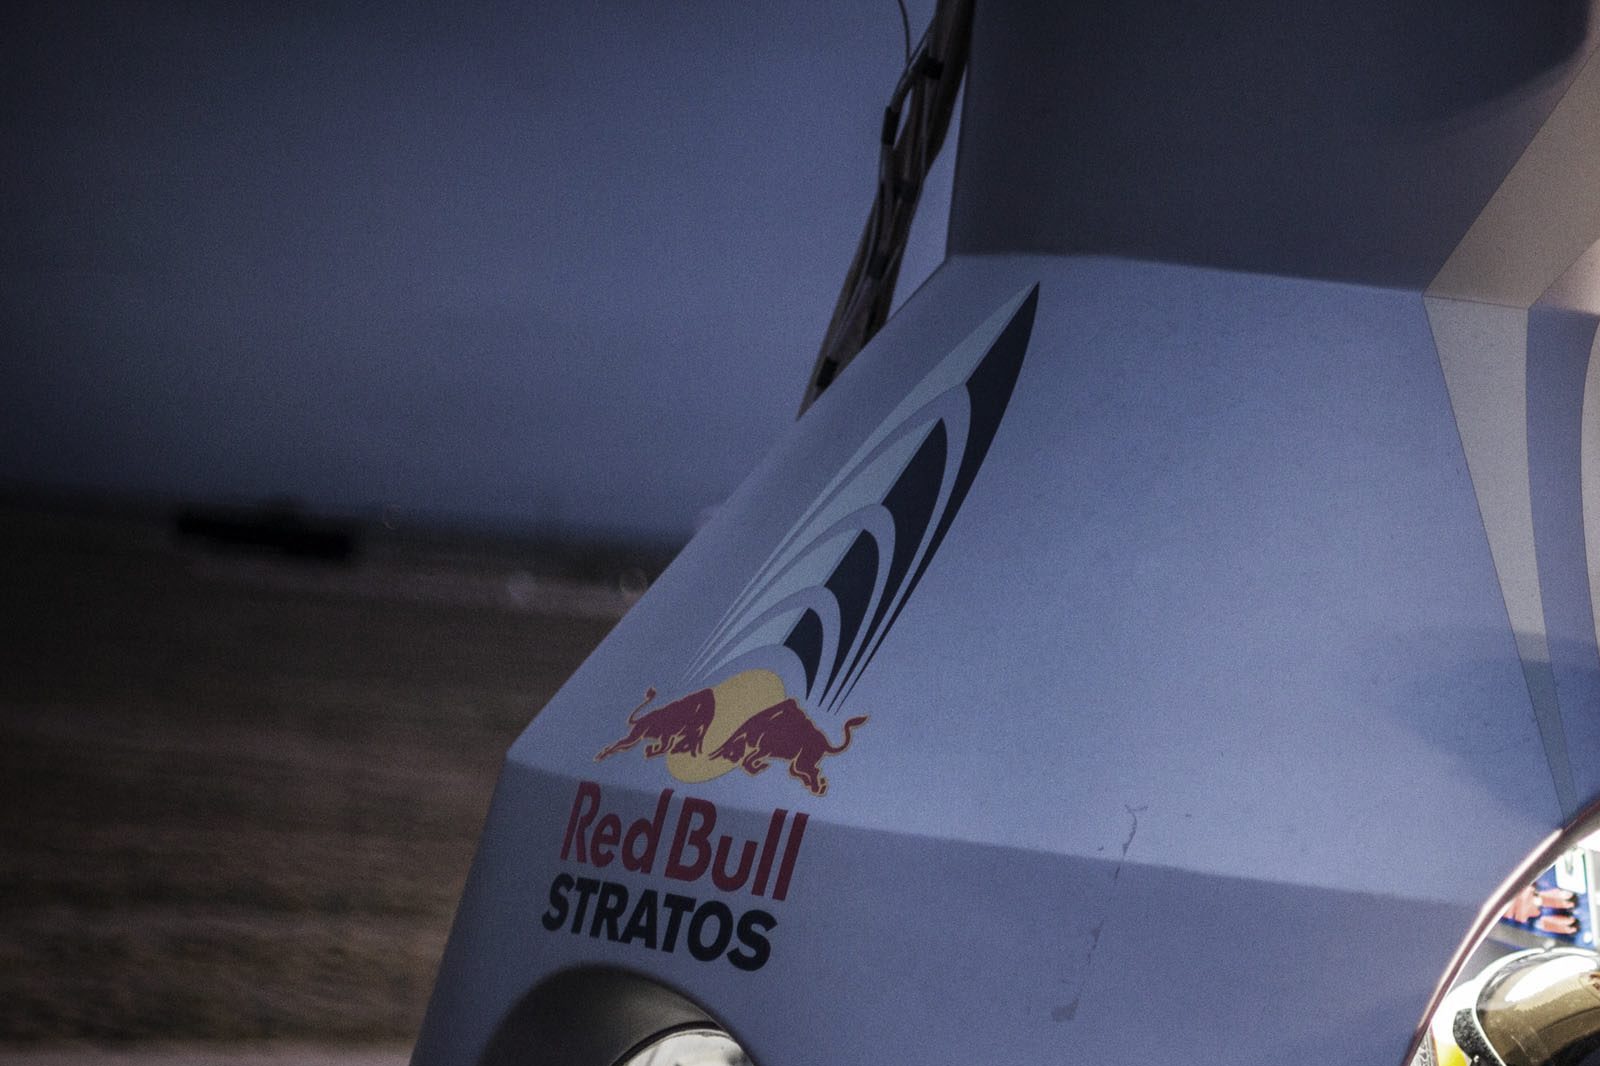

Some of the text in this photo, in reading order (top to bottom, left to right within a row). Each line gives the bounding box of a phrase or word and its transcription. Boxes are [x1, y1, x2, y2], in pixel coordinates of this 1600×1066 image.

[559, 780, 811, 902] Red Bull
[541, 872, 778, 972] STRATOS
